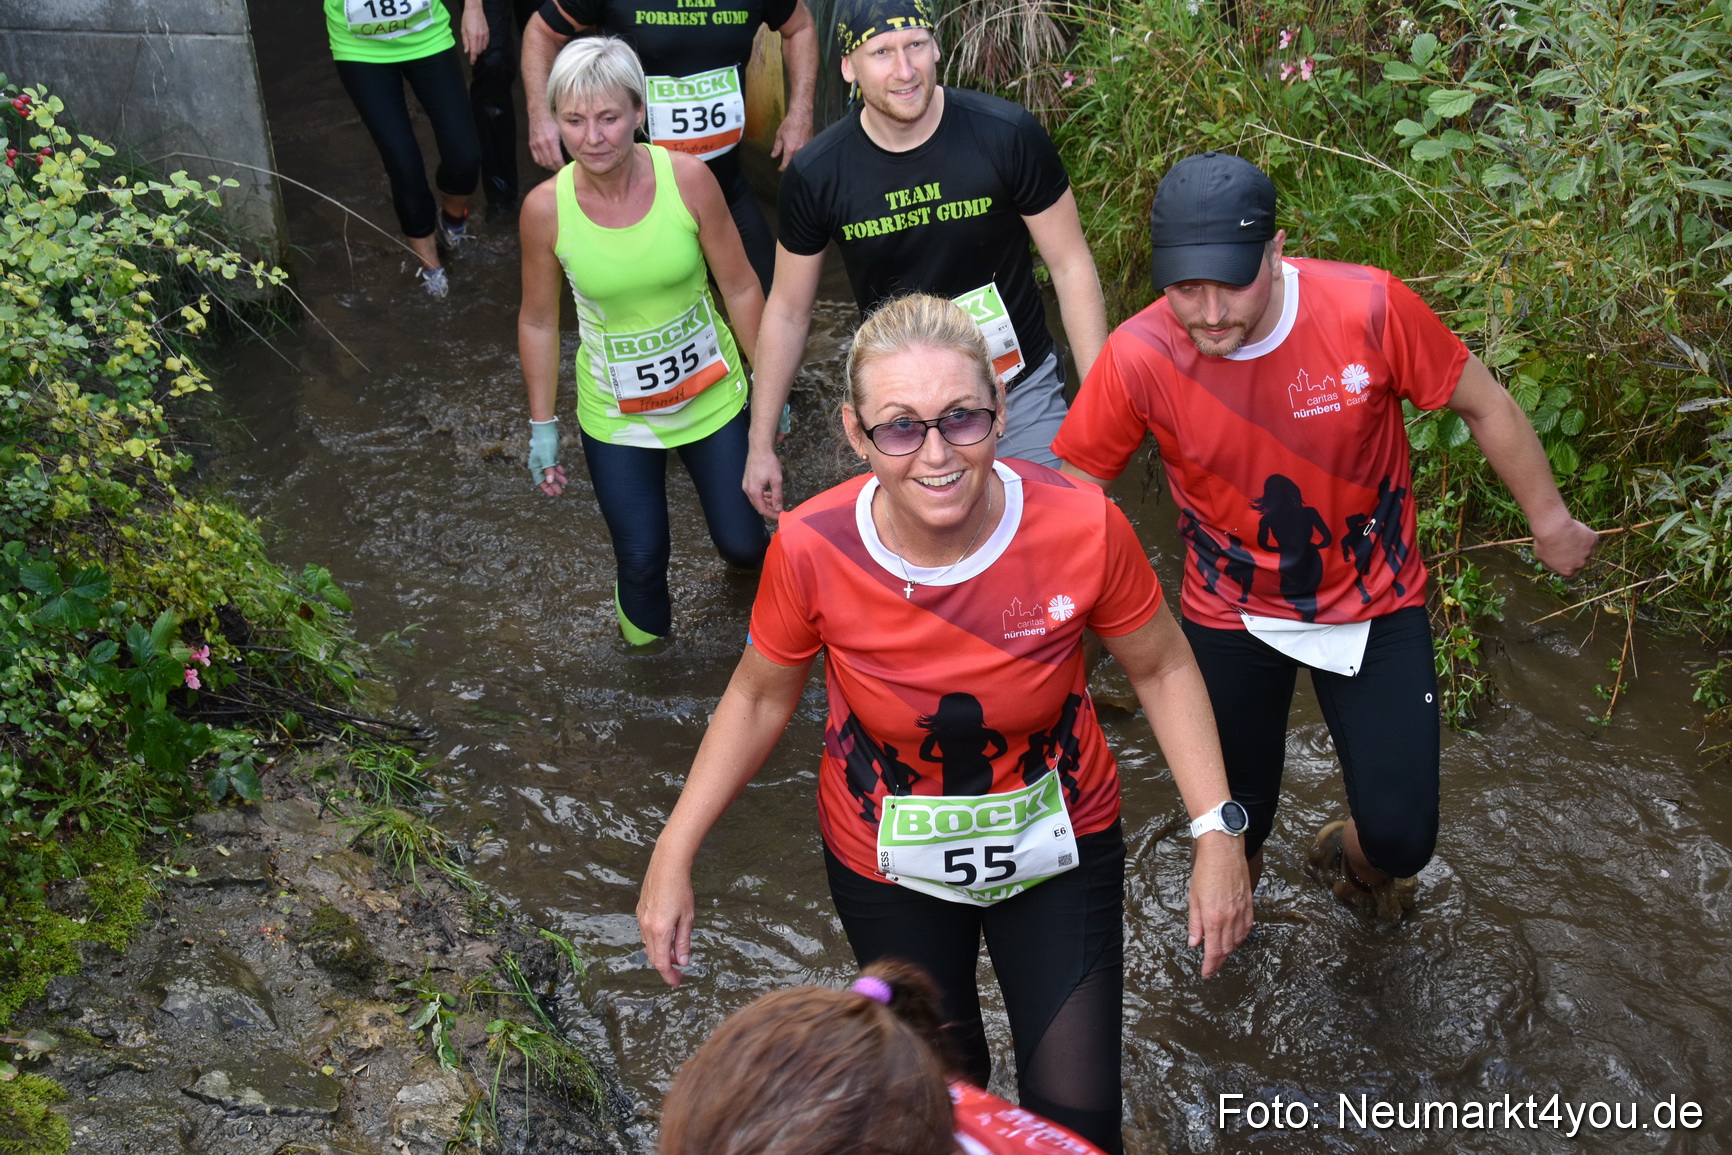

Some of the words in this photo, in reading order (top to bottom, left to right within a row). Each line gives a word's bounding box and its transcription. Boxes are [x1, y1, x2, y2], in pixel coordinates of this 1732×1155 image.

[364, 0, 412, 18] 183
[635, 10, 707, 25] FORREST
[712, 10, 749, 24] GUMP
[654, 73, 731, 99] BOCK
[672, 102, 726, 134] 536
[885, 182, 942, 210] TEAM
[842, 207, 931, 240] FORREST
[936, 197, 993, 221] GUMP
[611, 307, 704, 359] BOCK
[636, 342, 700, 391] 535
[1293, 402, 1341, 419] nürnberg
[1307, 392, 1338, 406] caritas
[1004, 627, 1046, 640] nürnberg
[1017, 618, 1044, 629] caritas
[894, 784, 1049, 839] BOCK
[1054, 826, 1066, 838] E6
[944, 845, 1017, 886] 55
